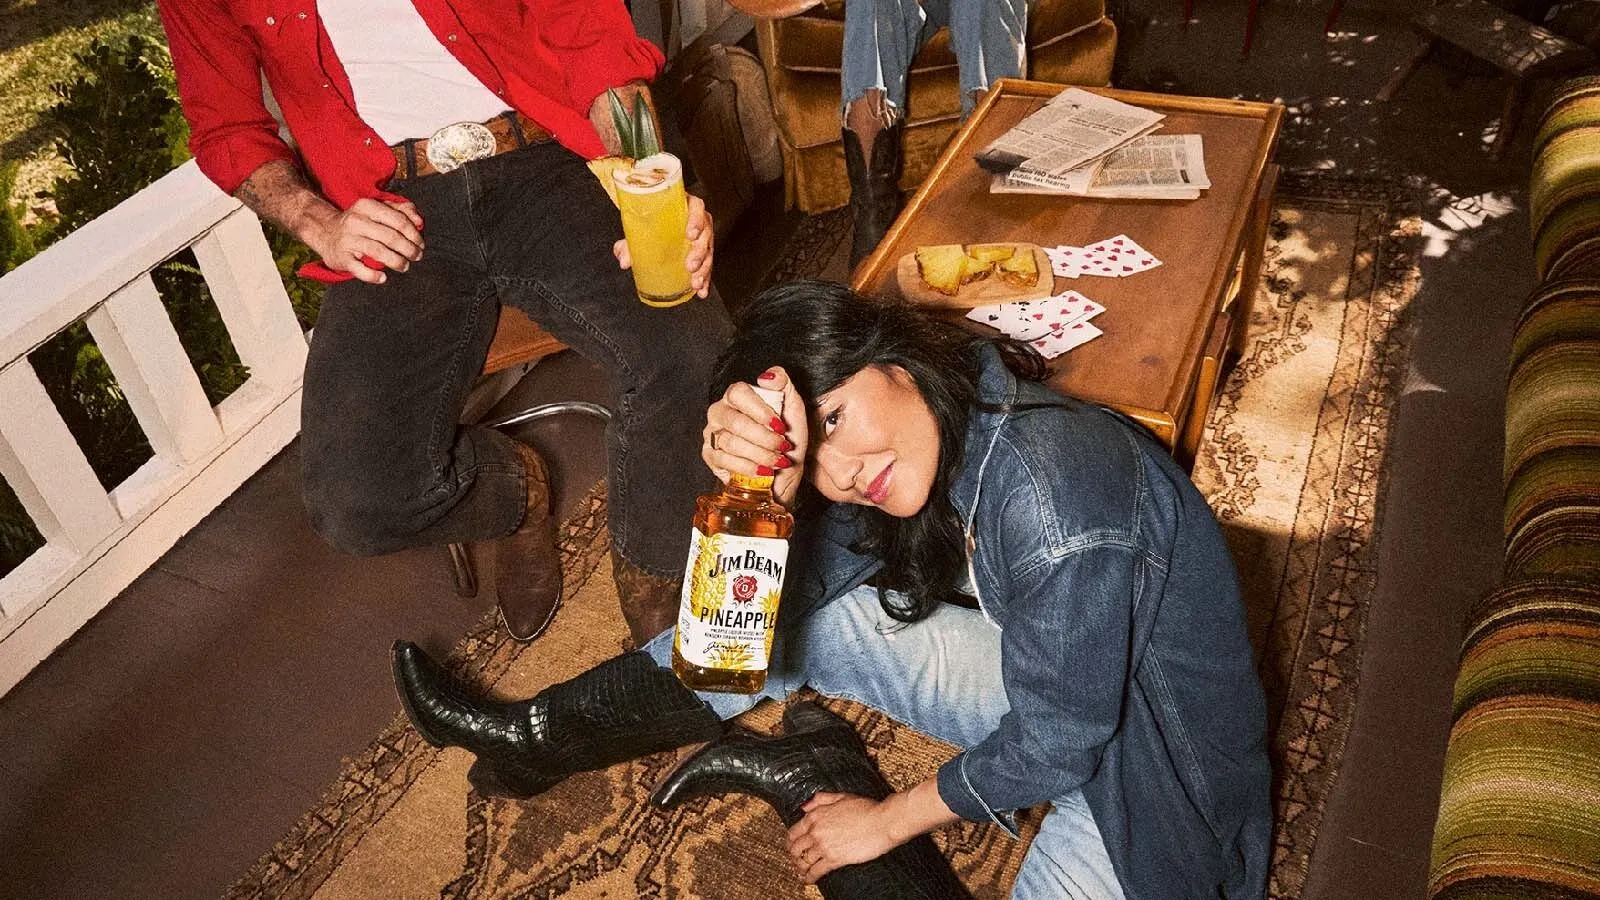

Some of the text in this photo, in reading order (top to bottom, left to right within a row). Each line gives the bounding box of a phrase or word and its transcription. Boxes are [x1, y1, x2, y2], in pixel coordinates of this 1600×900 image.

[1045, 178, 1071, 190] hearing
[709, 549, 783, 584] JIM BEAM
[700, 606, 775, 630] PINEAPPLE
